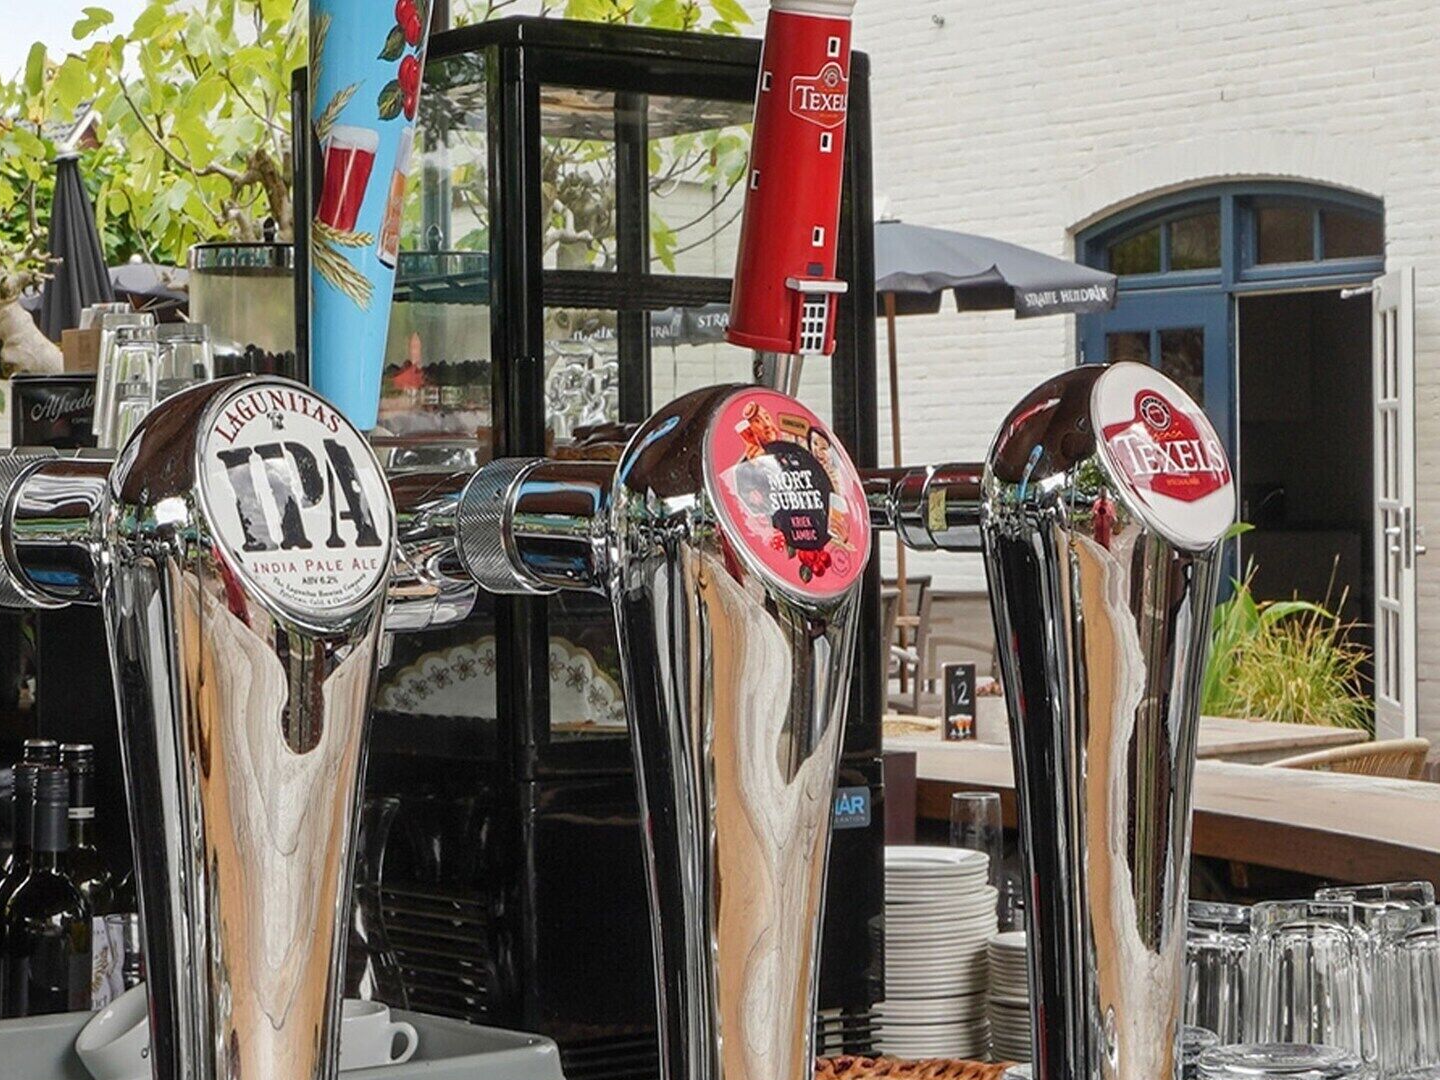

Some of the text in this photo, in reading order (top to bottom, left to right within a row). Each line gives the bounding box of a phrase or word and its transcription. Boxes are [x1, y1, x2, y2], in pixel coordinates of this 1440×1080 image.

[214, 389, 341, 444] LAGUNITAS
[1113, 433, 1226, 475] TEXELS
[767, 470, 812, 492] MORT
[216, 438, 382, 552] IPA
[770, 490, 824, 510] SUBITE
[253, 558, 378, 574] INDIA PALE ALE
[951, 681, 970, 706] 12
